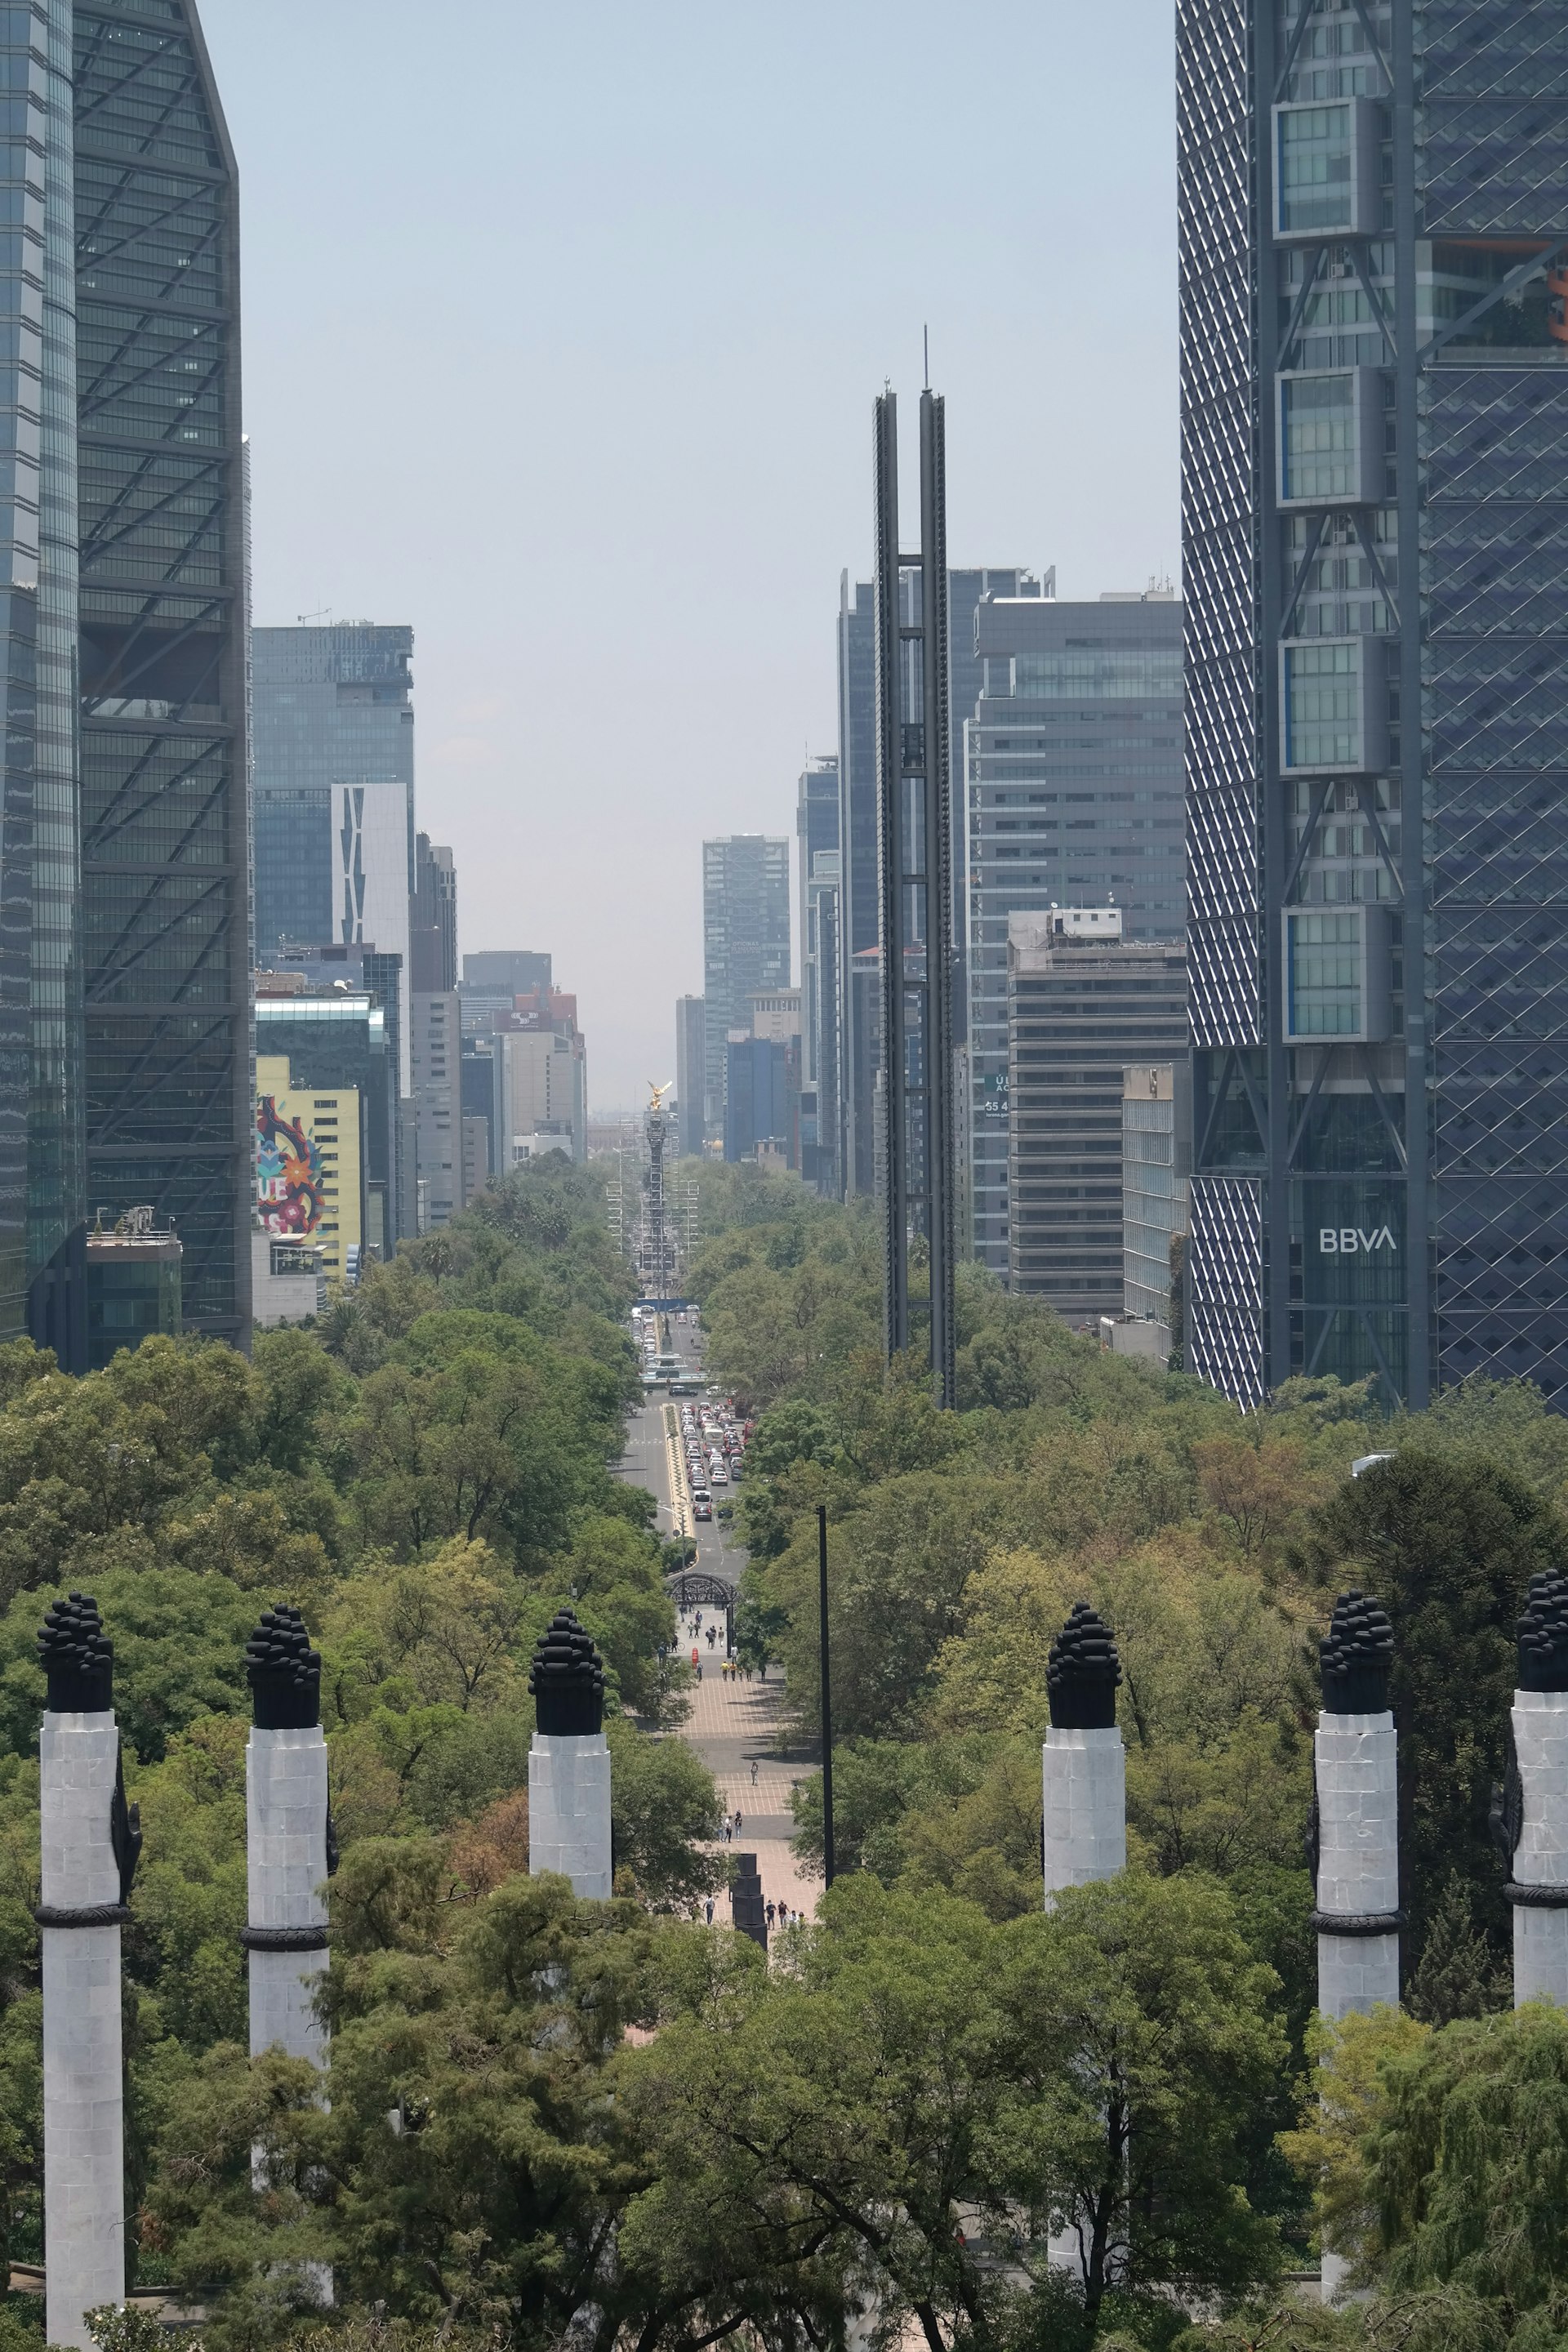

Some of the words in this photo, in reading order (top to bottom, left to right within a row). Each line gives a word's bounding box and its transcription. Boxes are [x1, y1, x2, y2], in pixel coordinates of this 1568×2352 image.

[986, 1102, 999, 1111] 55
[1001, 1102, 1009, 1111] 4
[1320, 1225, 1396, 1253] BBVA
